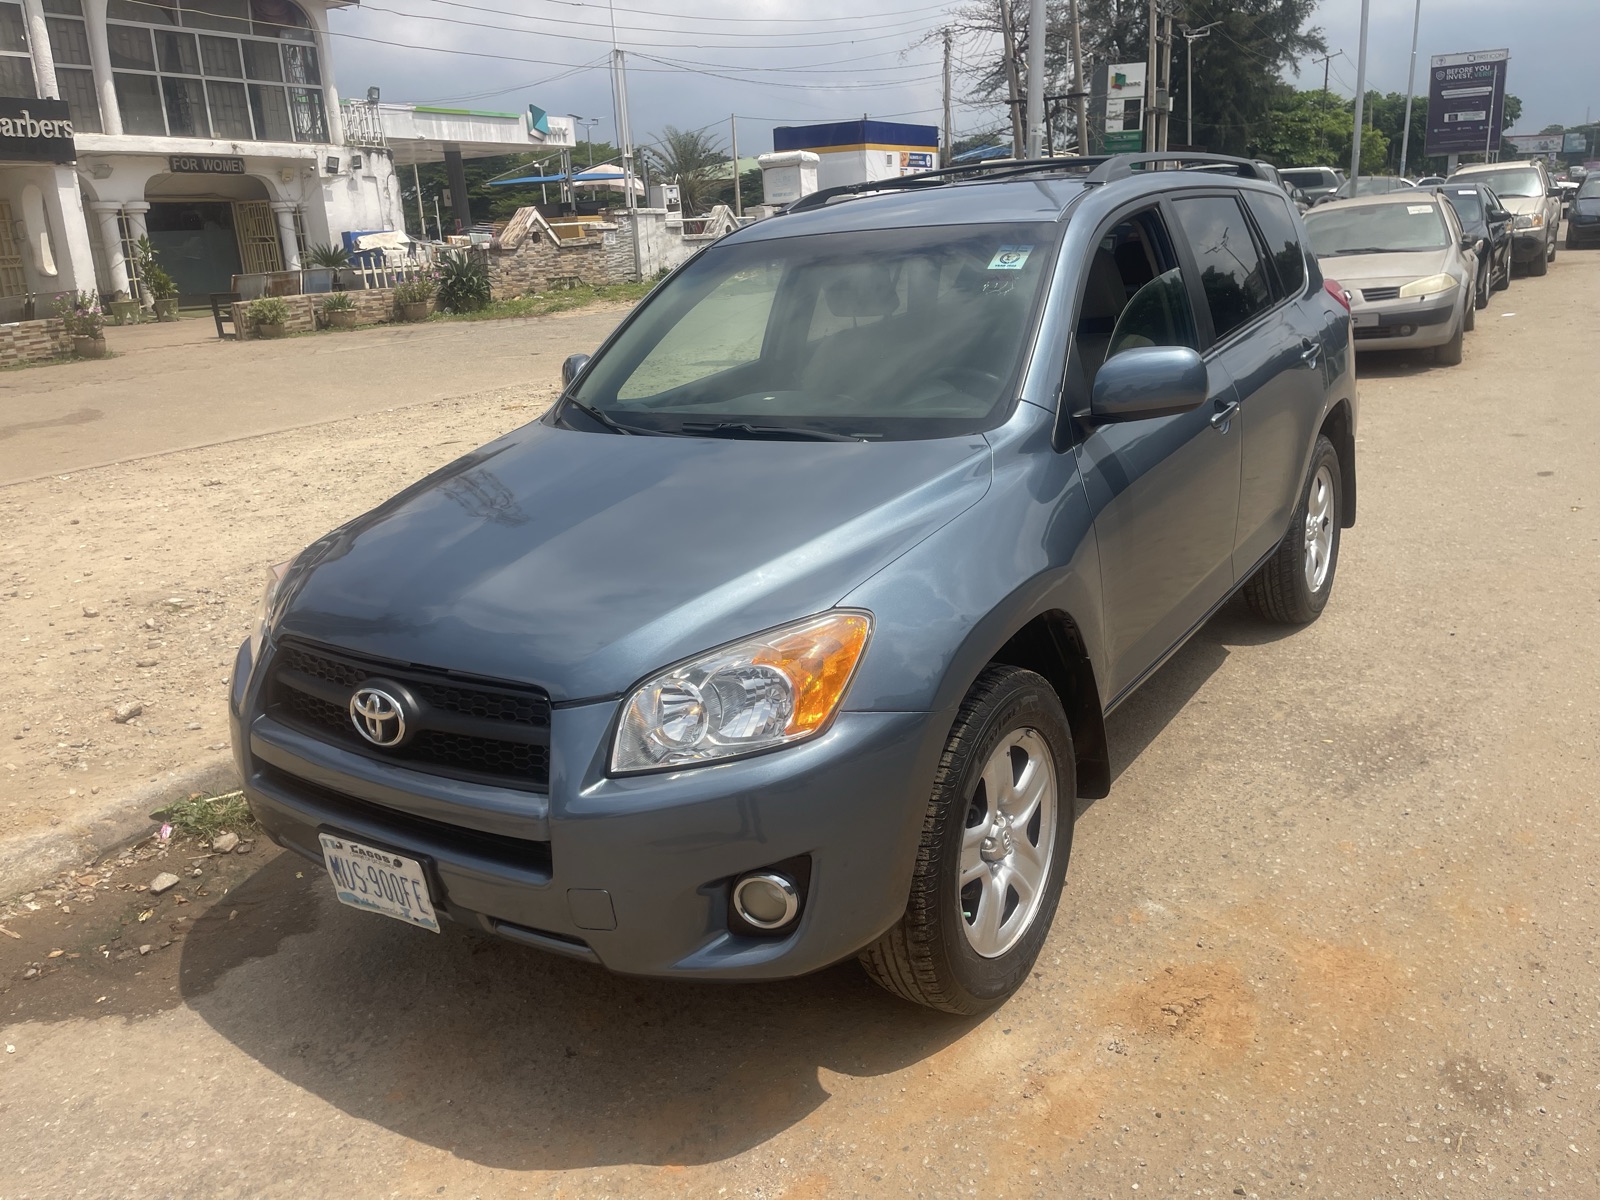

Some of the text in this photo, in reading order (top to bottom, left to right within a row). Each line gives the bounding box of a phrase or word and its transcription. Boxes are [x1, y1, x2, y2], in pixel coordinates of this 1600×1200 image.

[1446, 66, 1473, 75] BEFORE
[0, 109, 74, 138] arbers
[172, 158, 245, 172] FOR WOMEN
[350, 844, 390, 864] LAGOS
